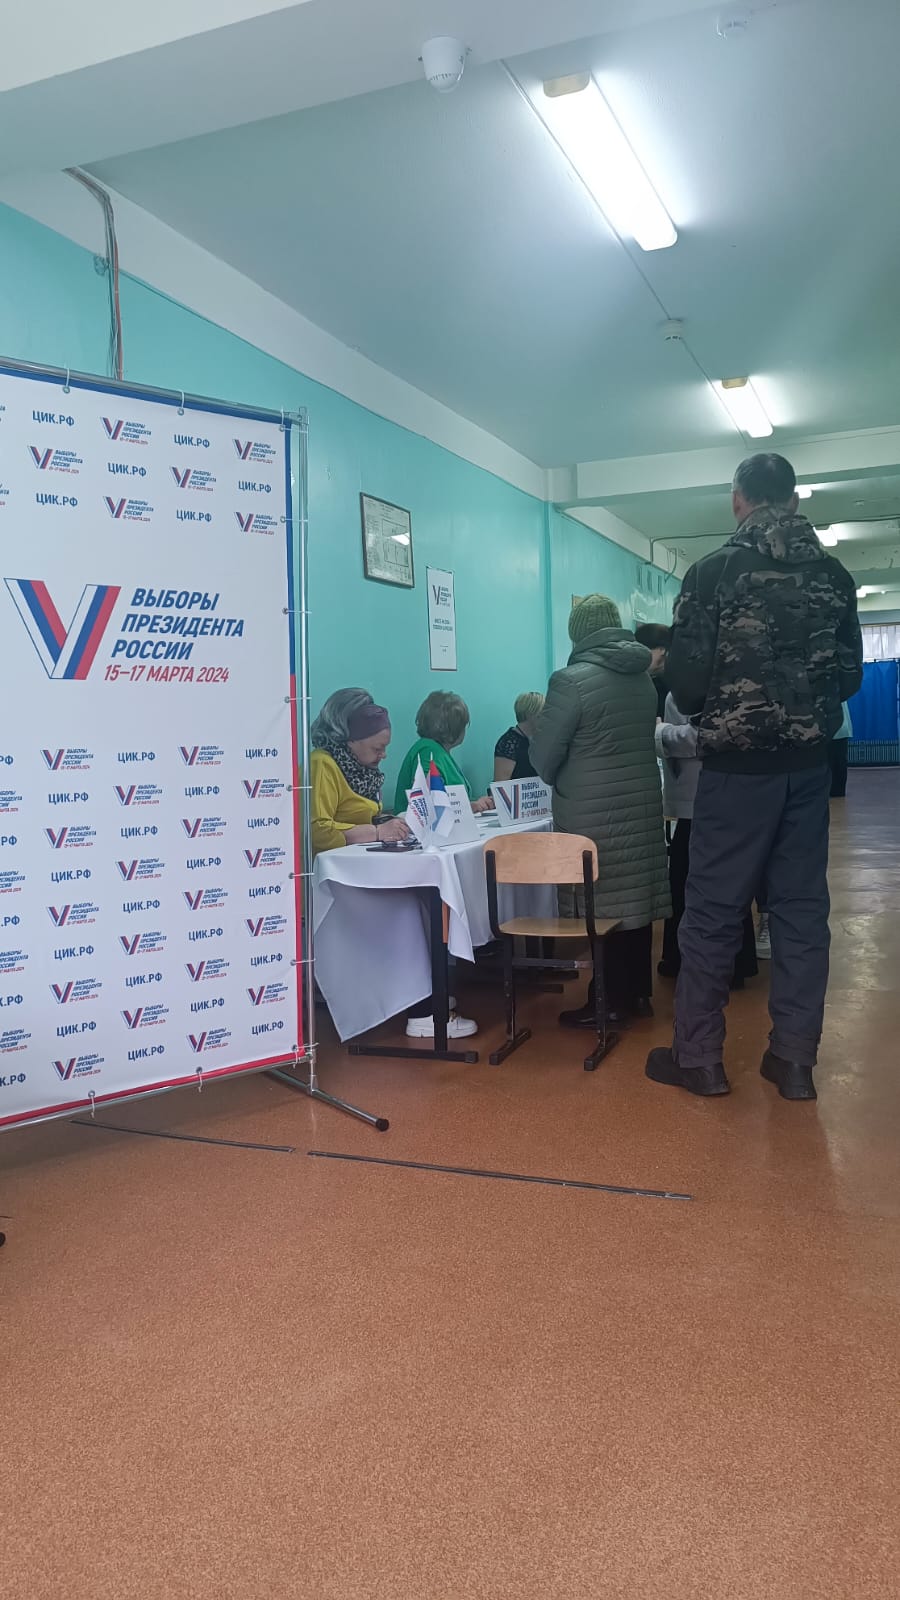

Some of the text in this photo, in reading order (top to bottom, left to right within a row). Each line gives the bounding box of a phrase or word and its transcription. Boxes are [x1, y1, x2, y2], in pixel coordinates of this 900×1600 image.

[33, 410, 74, 426] ЦИК.РФ
[174, 434, 209, 448] ЦИК.РФ
[108, 462, 146, 477] ЦИК.РФ
[239, 480, 271, 493] ЦИК.РФ
[36, 492, 77, 507] ЦИК.РФ
[177, 509, 211, 522] ЦИК.РФ
[130, 588, 220, 611] ВЫБОРЫ
[120, 613, 245, 638] ПРЕЗИДЕНТА
[111, 639, 195, 660] РОССИИ
[104, 664, 230, 683] 15–17 МАРТА 2024
[118, 751, 155, 763] ЦИК.РФ
[246, 747, 278, 759] ЦИК.РФ
[49, 791, 88, 805] ЦИК.РФ
[185, 785, 219, 797] ЦИК.РФ
[248, 816, 280, 829] ЦИК.РФ
[121, 825, 157, 838] ЦИК.РФ
[187, 856, 221, 869] ЦИК.РФ
[52, 868, 91, 883] ЦИК.РФ
[249, 885, 281, 898] ЦИК.РФ
[123, 899, 160, 913] ЦИК.РФ
[189, 927, 223, 941] ЦИК.РФ
[55, 944, 94, 960] ЦИК.РФ
[251, 952, 282, 966] ЦИК.РФ
[126, 972, 162, 987] ЦИК.РФ
[191, 997, 224, 1012] ЦИК.РФ
[57, 1020, 96, 1037] ЦИК.РФ
[252, 1020, 283, 1035] ЦИК.РФ
[128, 1044, 164, 1061] ЦИК.РФ
